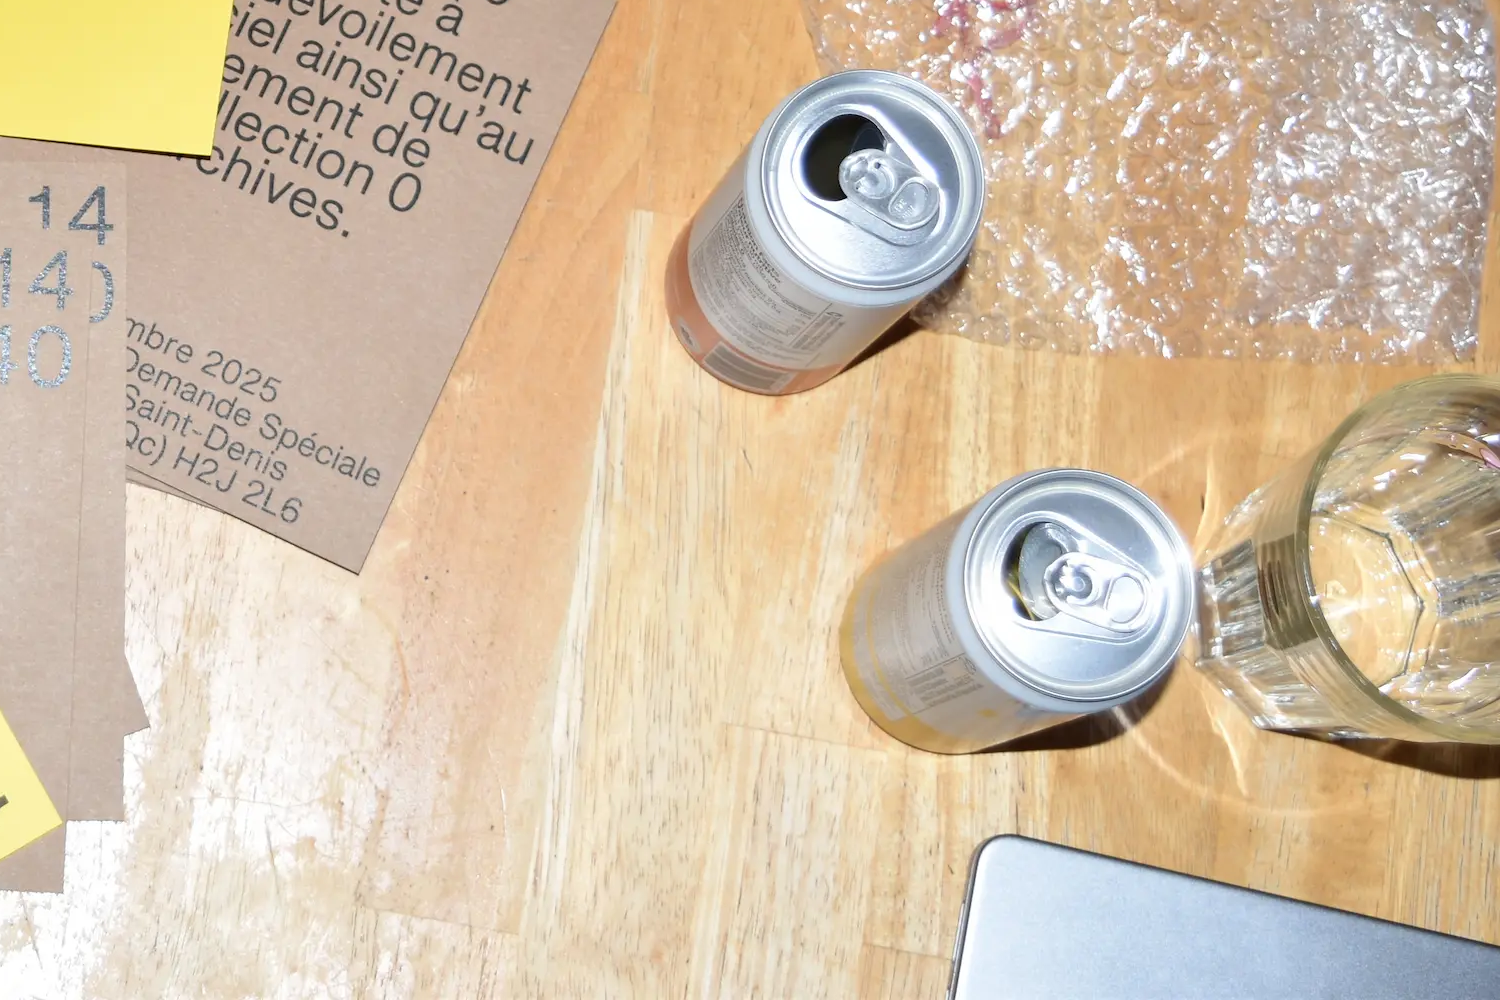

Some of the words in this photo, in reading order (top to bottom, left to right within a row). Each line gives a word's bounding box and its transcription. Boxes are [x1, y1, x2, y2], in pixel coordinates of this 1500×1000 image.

[295, 38, 404, 105] ainsi
[221, 52, 364, 139] ement
[372, 120, 431, 169] de
[28, 185, 114, 246] 14
[388, 171, 422, 213] 0
[201, 350, 282, 403] 2025
[126, 383, 288, 481] Saint-Denis
[259, 413, 381, 487] Spéciale
[173, 446, 238, 493] H2J
[242, 479, 303, 524] 2L6
